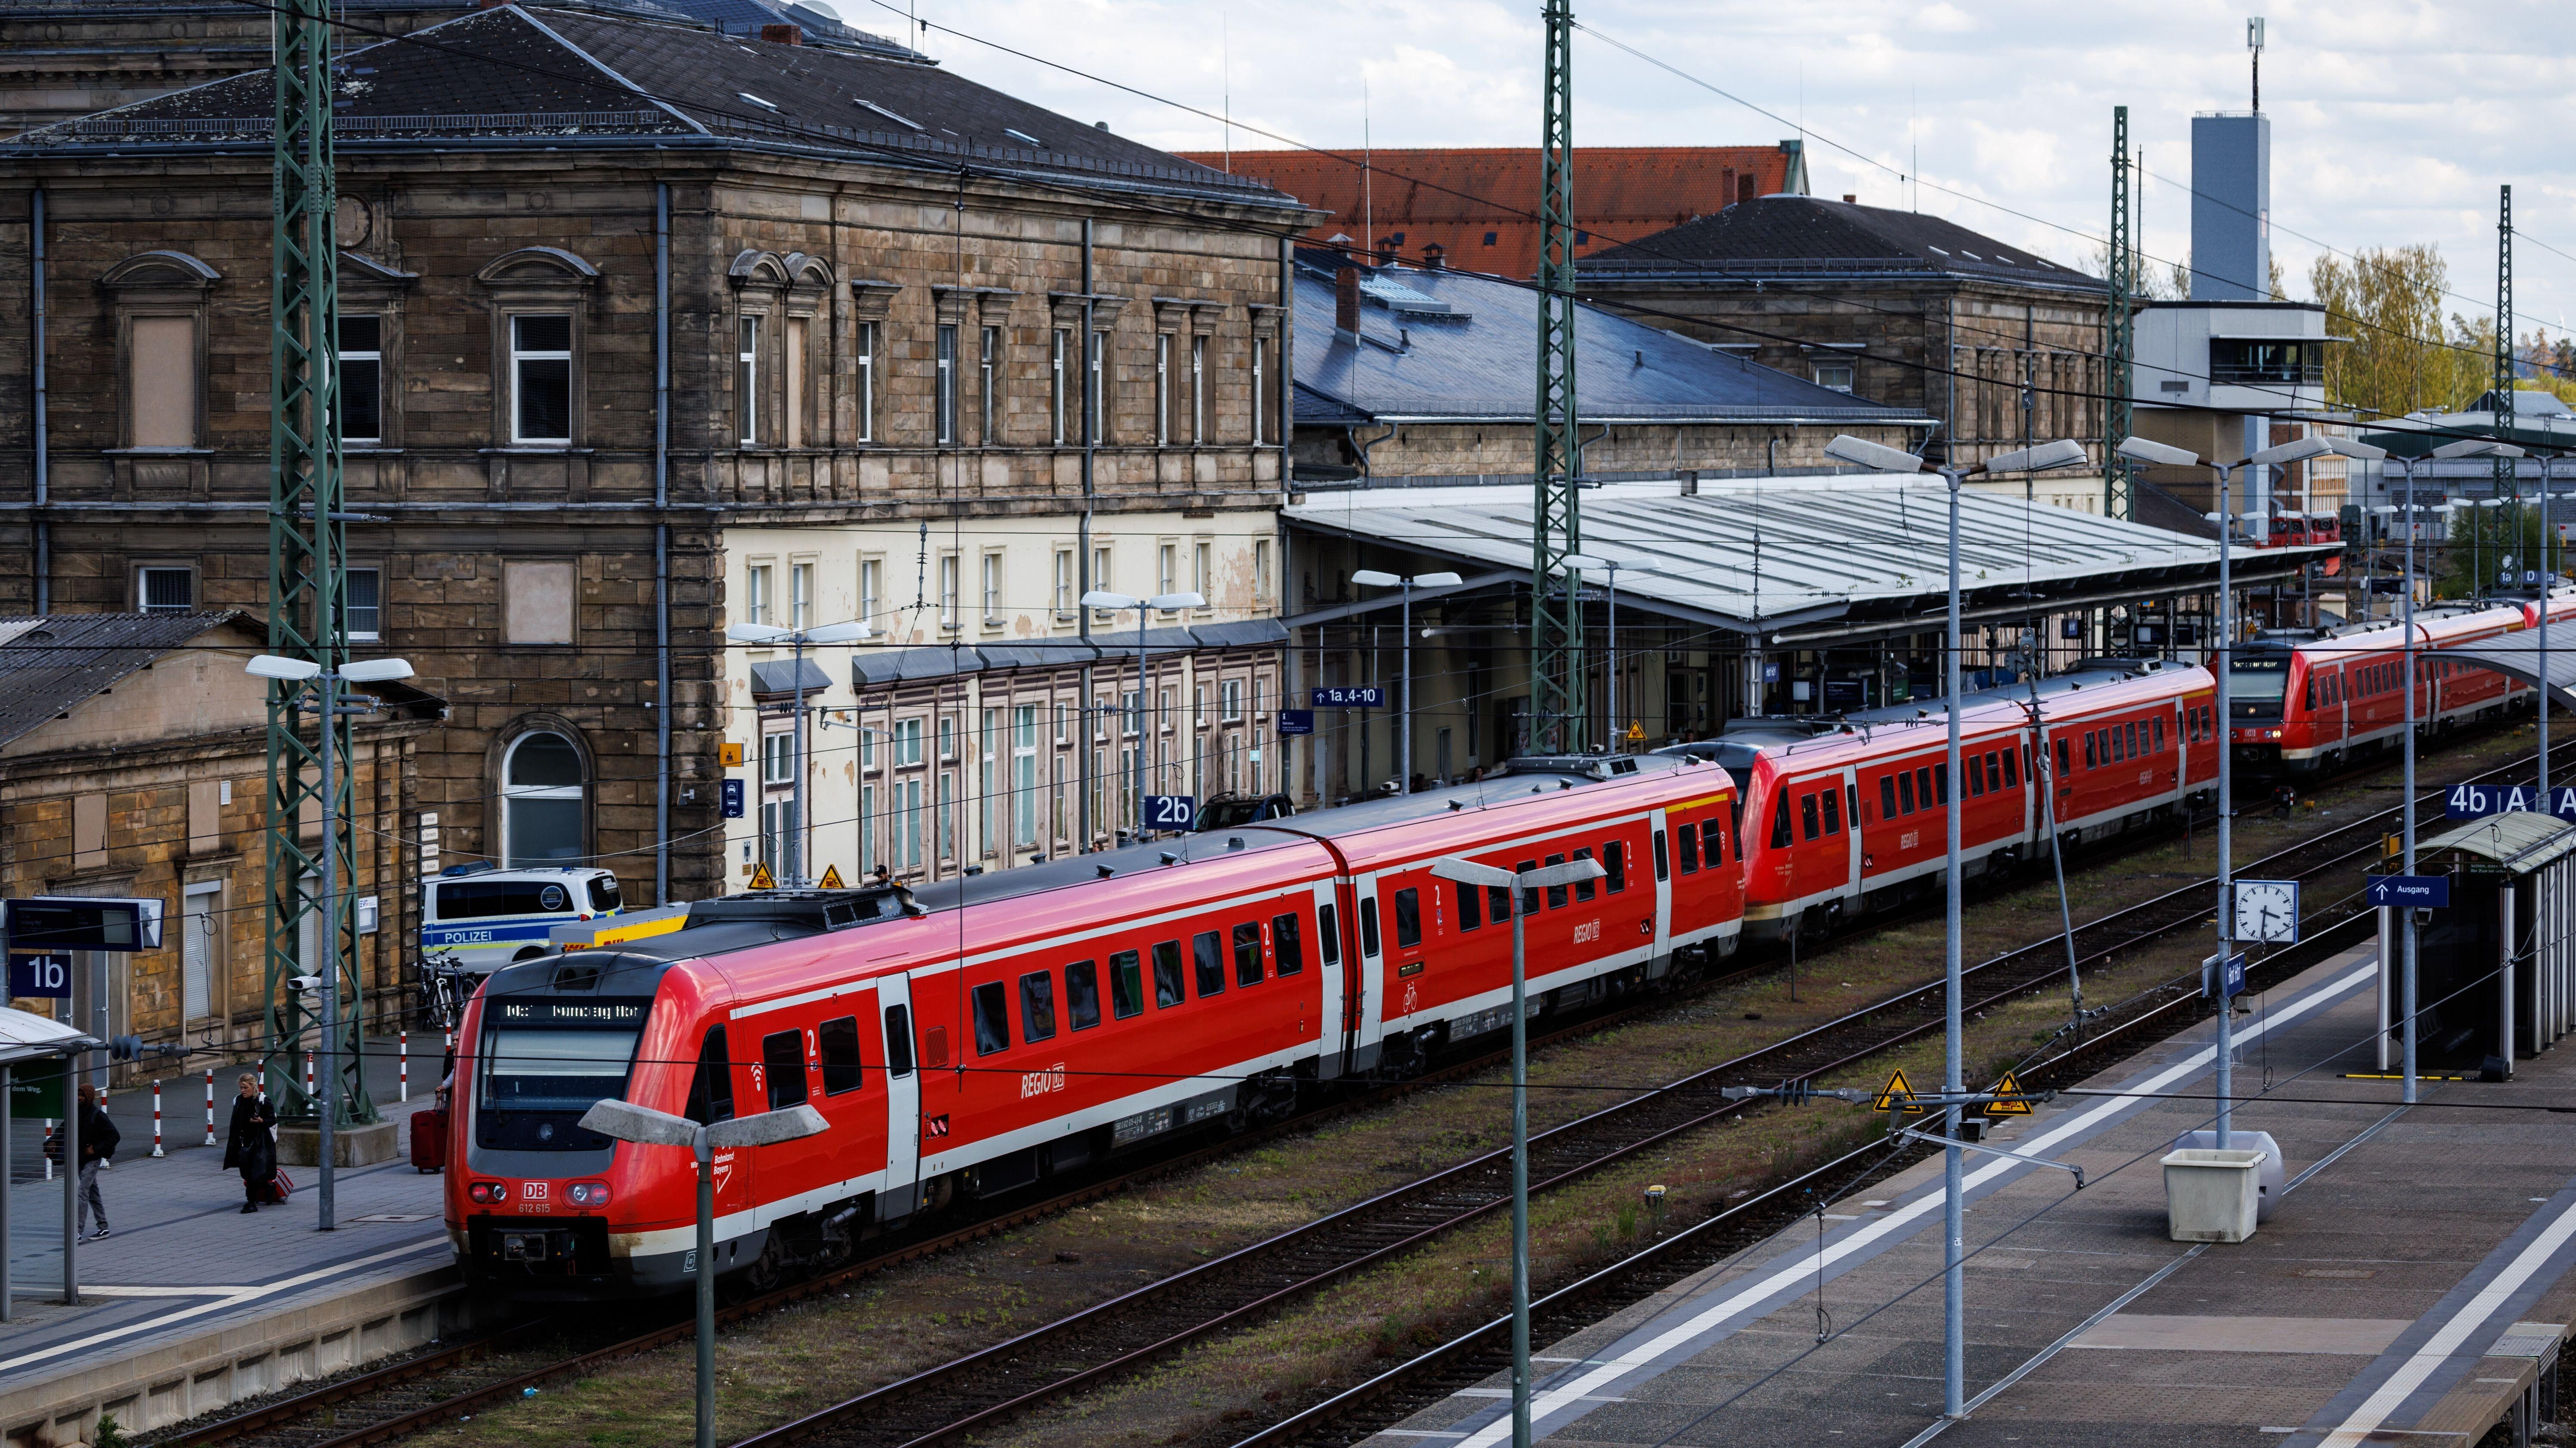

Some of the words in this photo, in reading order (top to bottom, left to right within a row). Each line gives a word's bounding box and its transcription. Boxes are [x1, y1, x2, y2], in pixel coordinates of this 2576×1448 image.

[2501, 571, 2512, 581] 1a
[2527, 571, 2535, 581] D
[1818, 796, 1822, 812] 2
[2451, 786, 2486, 812] 4b
[2505, 787, 2527, 812] A
[2558, 788, 2576, 814] A
[1157, 796, 1189, 823] 2b
[1697, 824, 1701, 842] 1
[1627, 841, 1631, 860] 2
[1435, 885, 1441, 905] 2
[2397, 886, 2429, 895] Ausgang
[445, 931, 492, 943] POLIZEI
[1574, 923, 1592, 945] REGIO
[29, 956, 64, 988] 1b
[807, 1029, 816, 1057] 2
[1021, 1068, 1051, 1099] REGIO
[1053, 1067, 1063, 1088] DB
[715, 1151, 734, 1164] Bahnland
[714, 1165, 728, 1175] Bayern
[525, 1184, 546, 1198] DB
[519, 1204, 533, 1212] 612
[536, 1204, 550, 1213] 615
